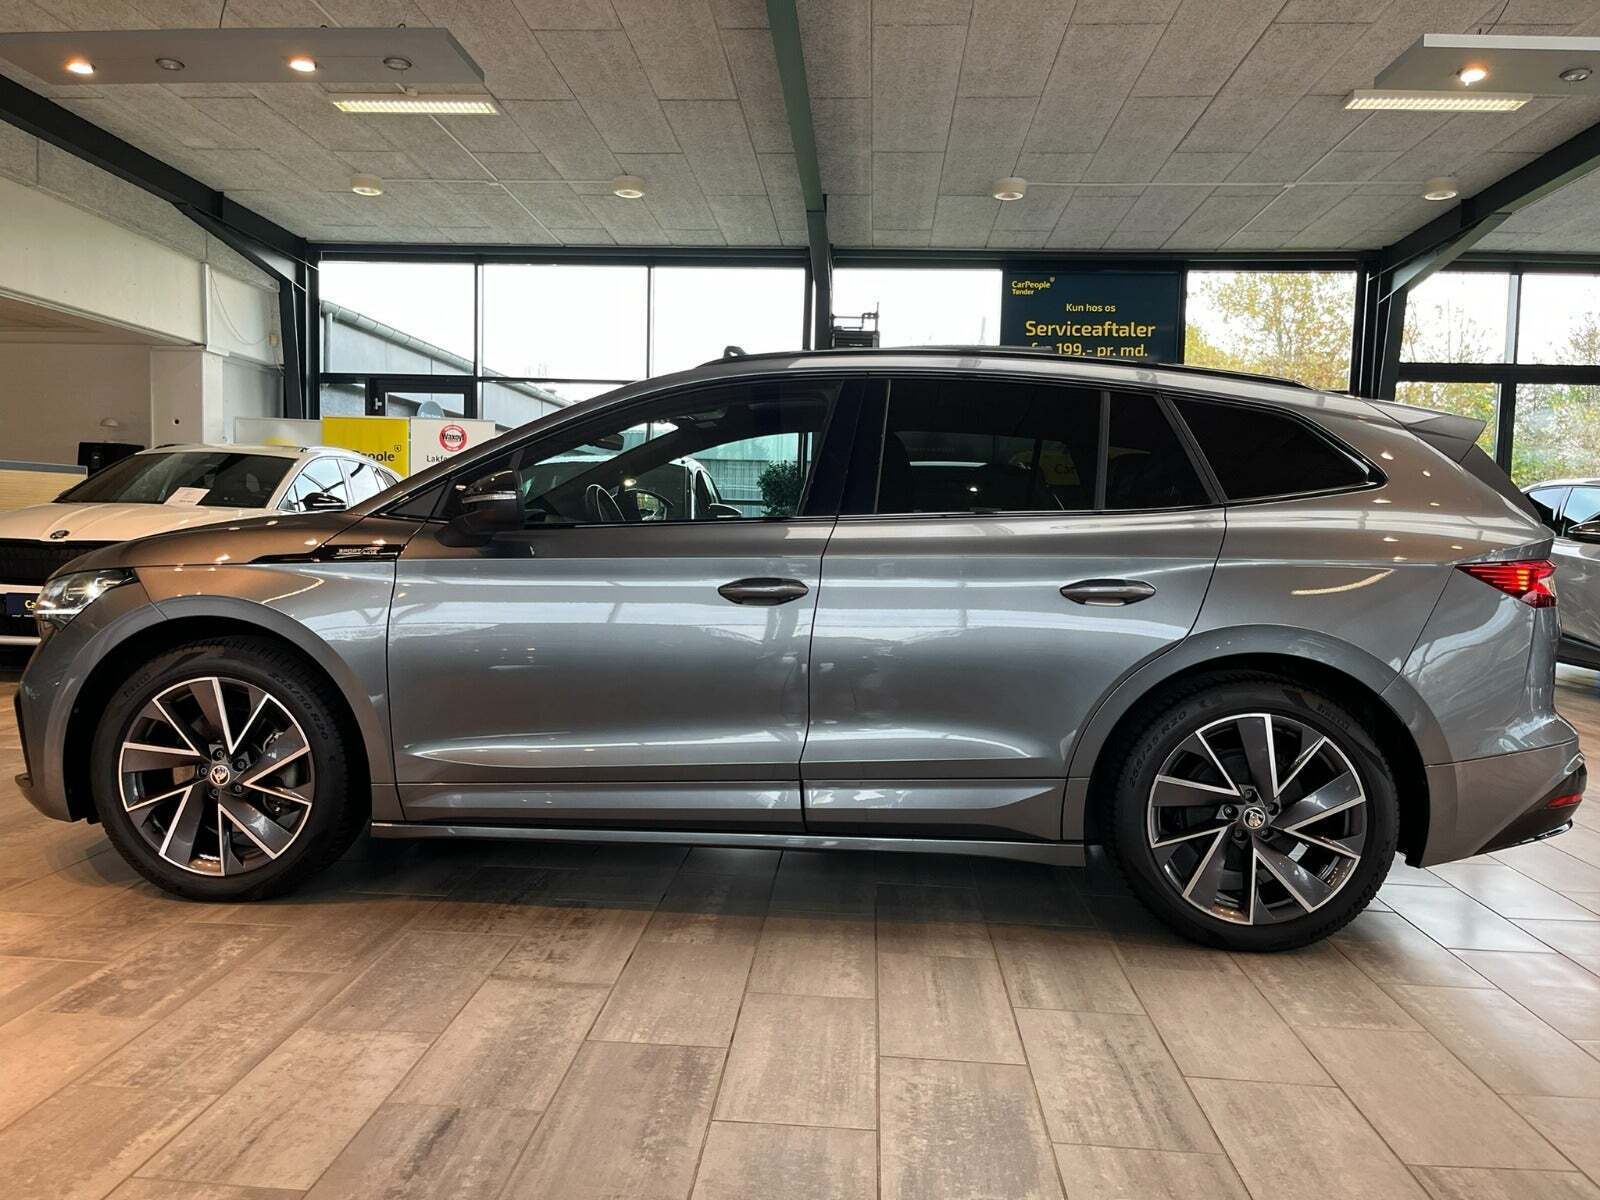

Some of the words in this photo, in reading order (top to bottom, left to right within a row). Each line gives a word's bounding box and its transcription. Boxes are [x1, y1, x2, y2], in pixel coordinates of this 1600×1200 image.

[1011, 280, 1051, 290] CarPeople
[1066, 303, 1084, 312] Kun
[1086, 303, 1103, 312] hos
[1025, 320, 1156, 337] Serviceaftaler
[1097, 345, 1116, 357] pr.
[1120, 344, 1148, 357] md.
